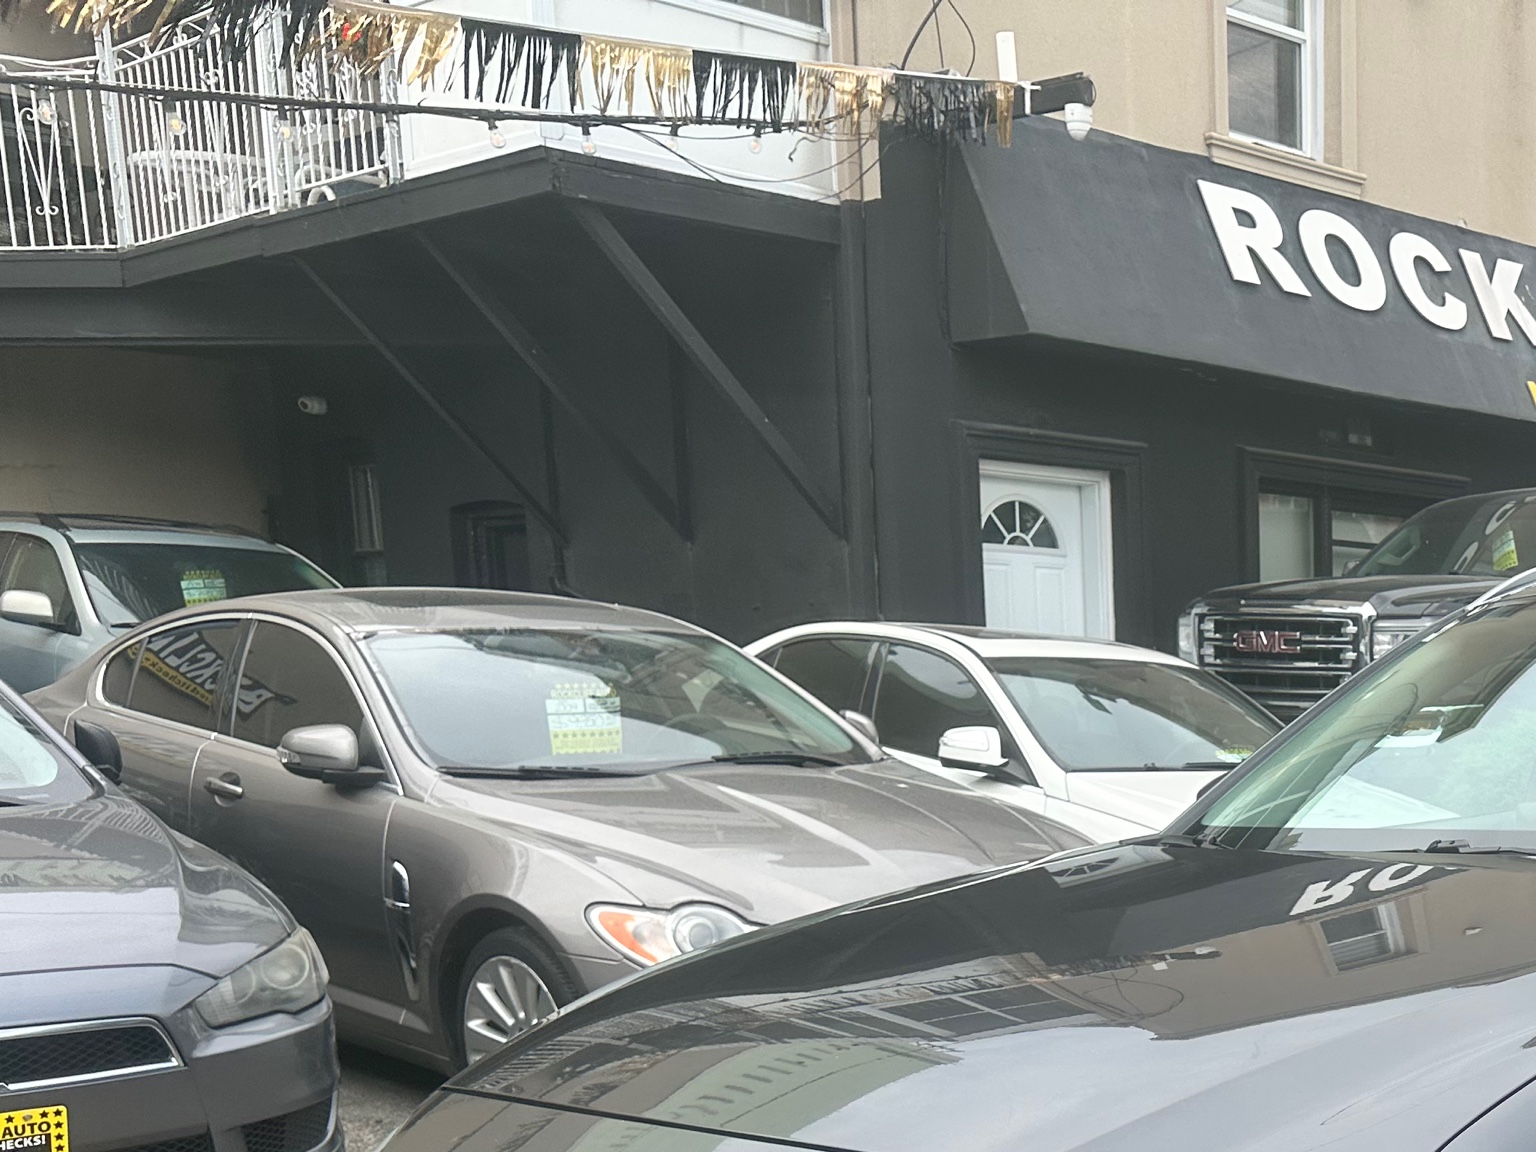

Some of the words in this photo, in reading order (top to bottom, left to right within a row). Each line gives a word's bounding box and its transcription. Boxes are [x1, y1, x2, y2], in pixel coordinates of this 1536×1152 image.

[1233, 631, 1301, 653] GMC
[2, 1121, 51, 1138] AUTO
[0, 1135, 46, 1150] HECKS!
